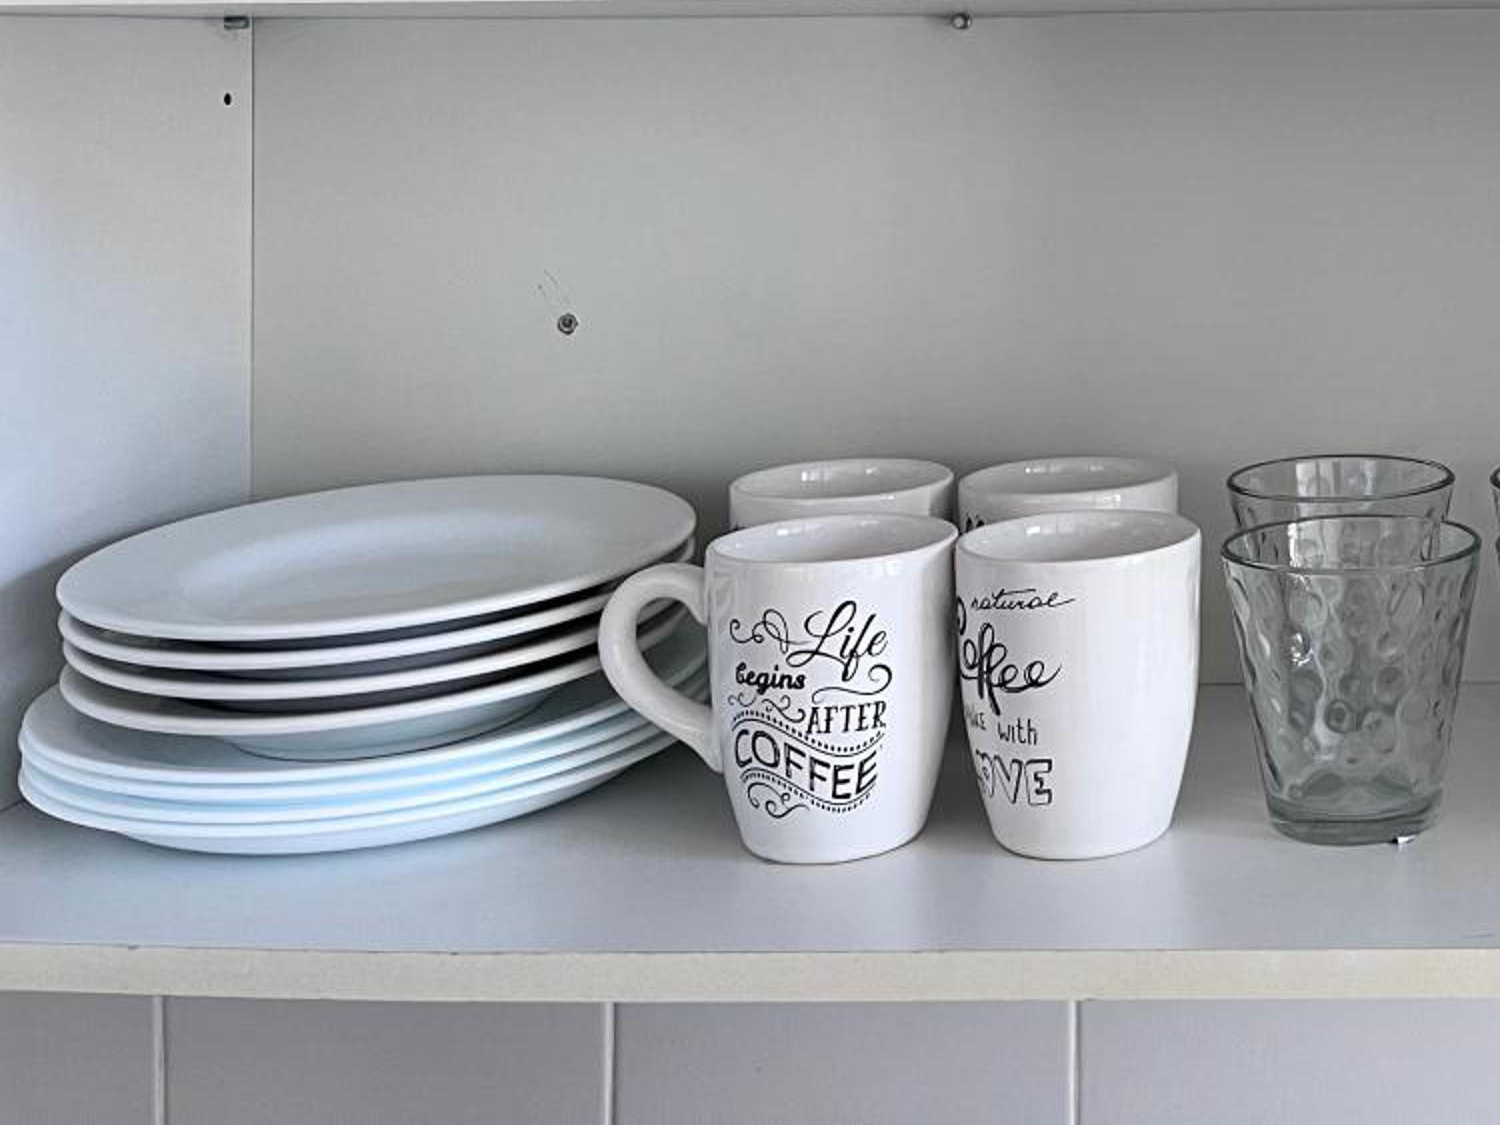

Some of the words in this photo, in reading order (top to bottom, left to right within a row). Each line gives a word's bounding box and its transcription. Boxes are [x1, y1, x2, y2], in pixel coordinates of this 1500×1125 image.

[970, 588, 1077, 610] natural
[786, 600, 888, 682] Life
[958, 597, 1062, 715] offee
[735, 662, 807, 695] begins
[805, 700, 887, 735] AFTER
[998, 718, 1037, 745] with
[735, 729, 878, 800] COFFEE
[976, 749, 1053, 806] OVE
